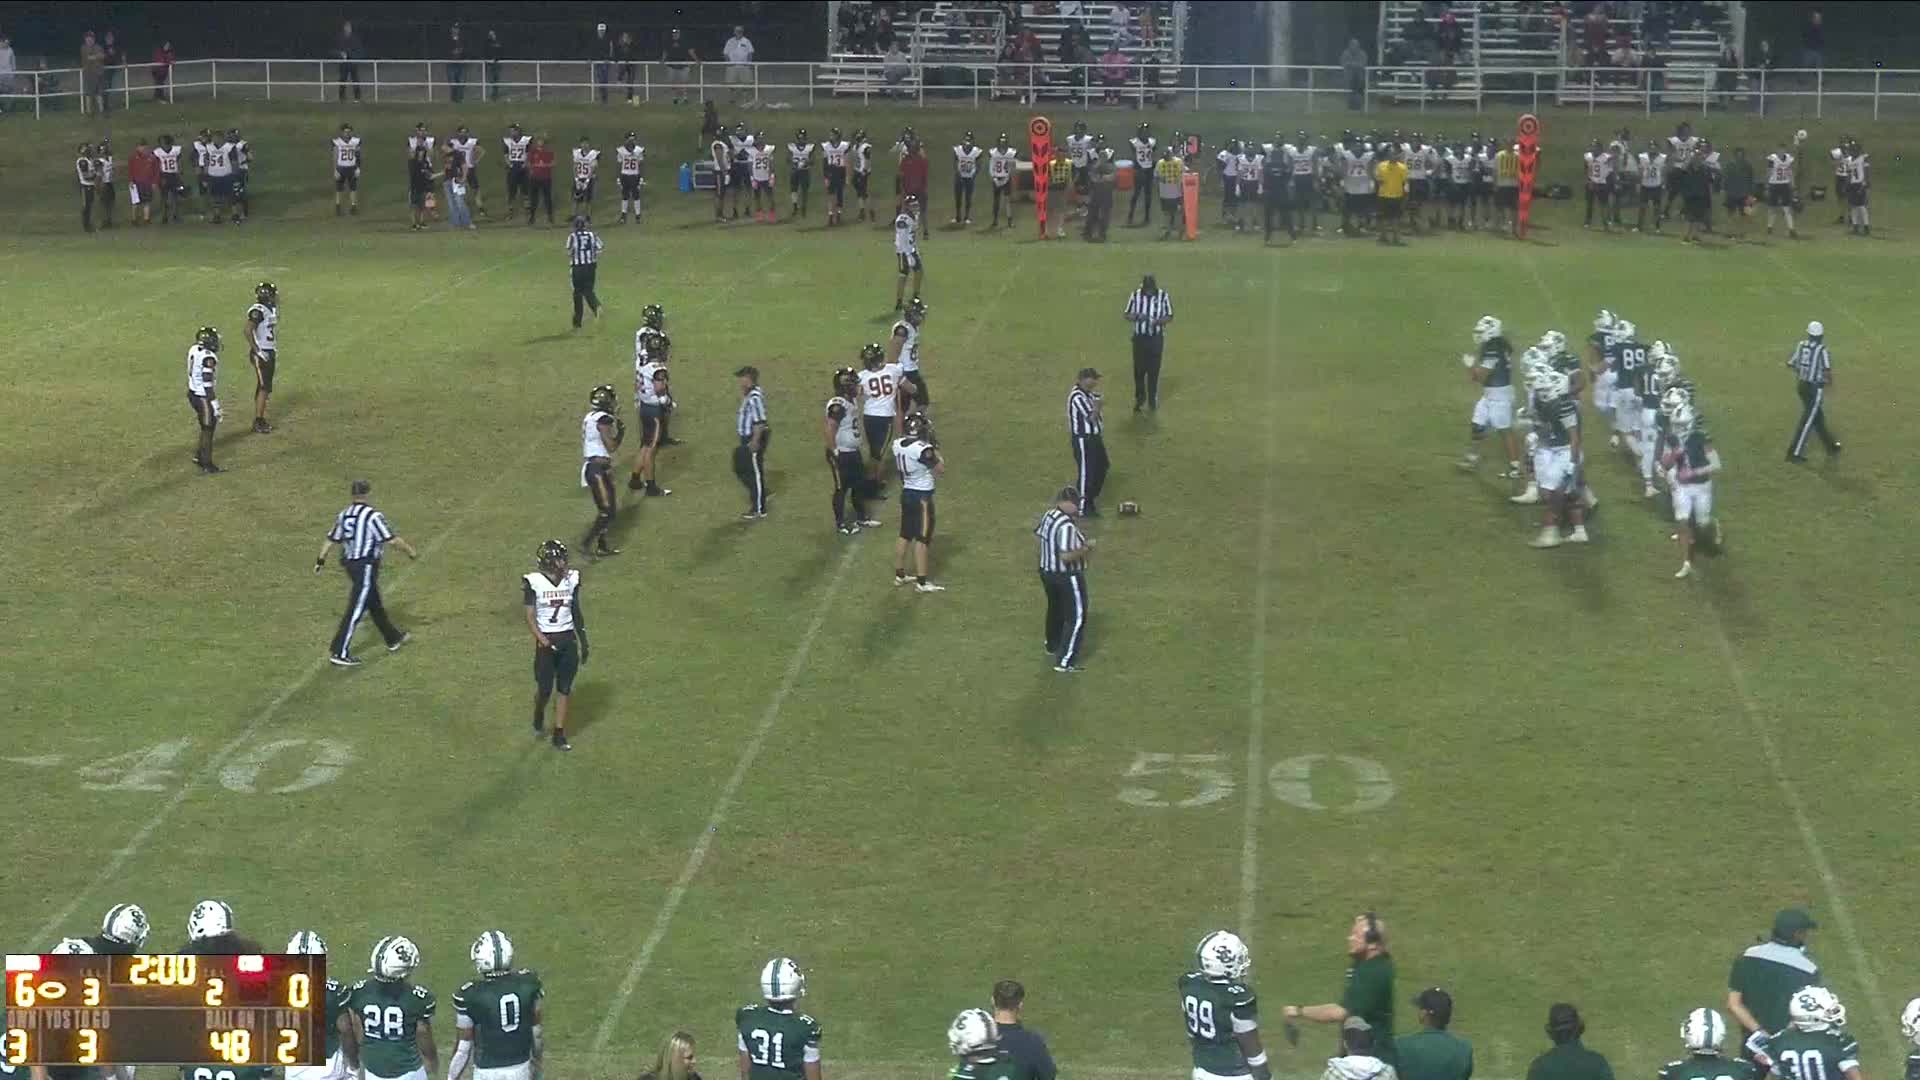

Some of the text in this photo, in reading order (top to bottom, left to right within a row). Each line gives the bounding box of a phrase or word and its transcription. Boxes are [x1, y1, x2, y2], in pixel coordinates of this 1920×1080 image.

[581, 235, 589, 250] F
[1623, 349, 1645, 371] 89
[867, 374, 893, 398] 96
[343, 517, 356, 538] S
[549, 599, 564, 624] 7
[1117, 752, 1394, 813] 50
[363, 1004, 404, 1040] 28
[499, 993, 521, 1033] 0
[1185, 995, 1217, 1039] 99
[751, 1028, 786, 1068] 31
[1779, 1049, 1826, 1080] 30
